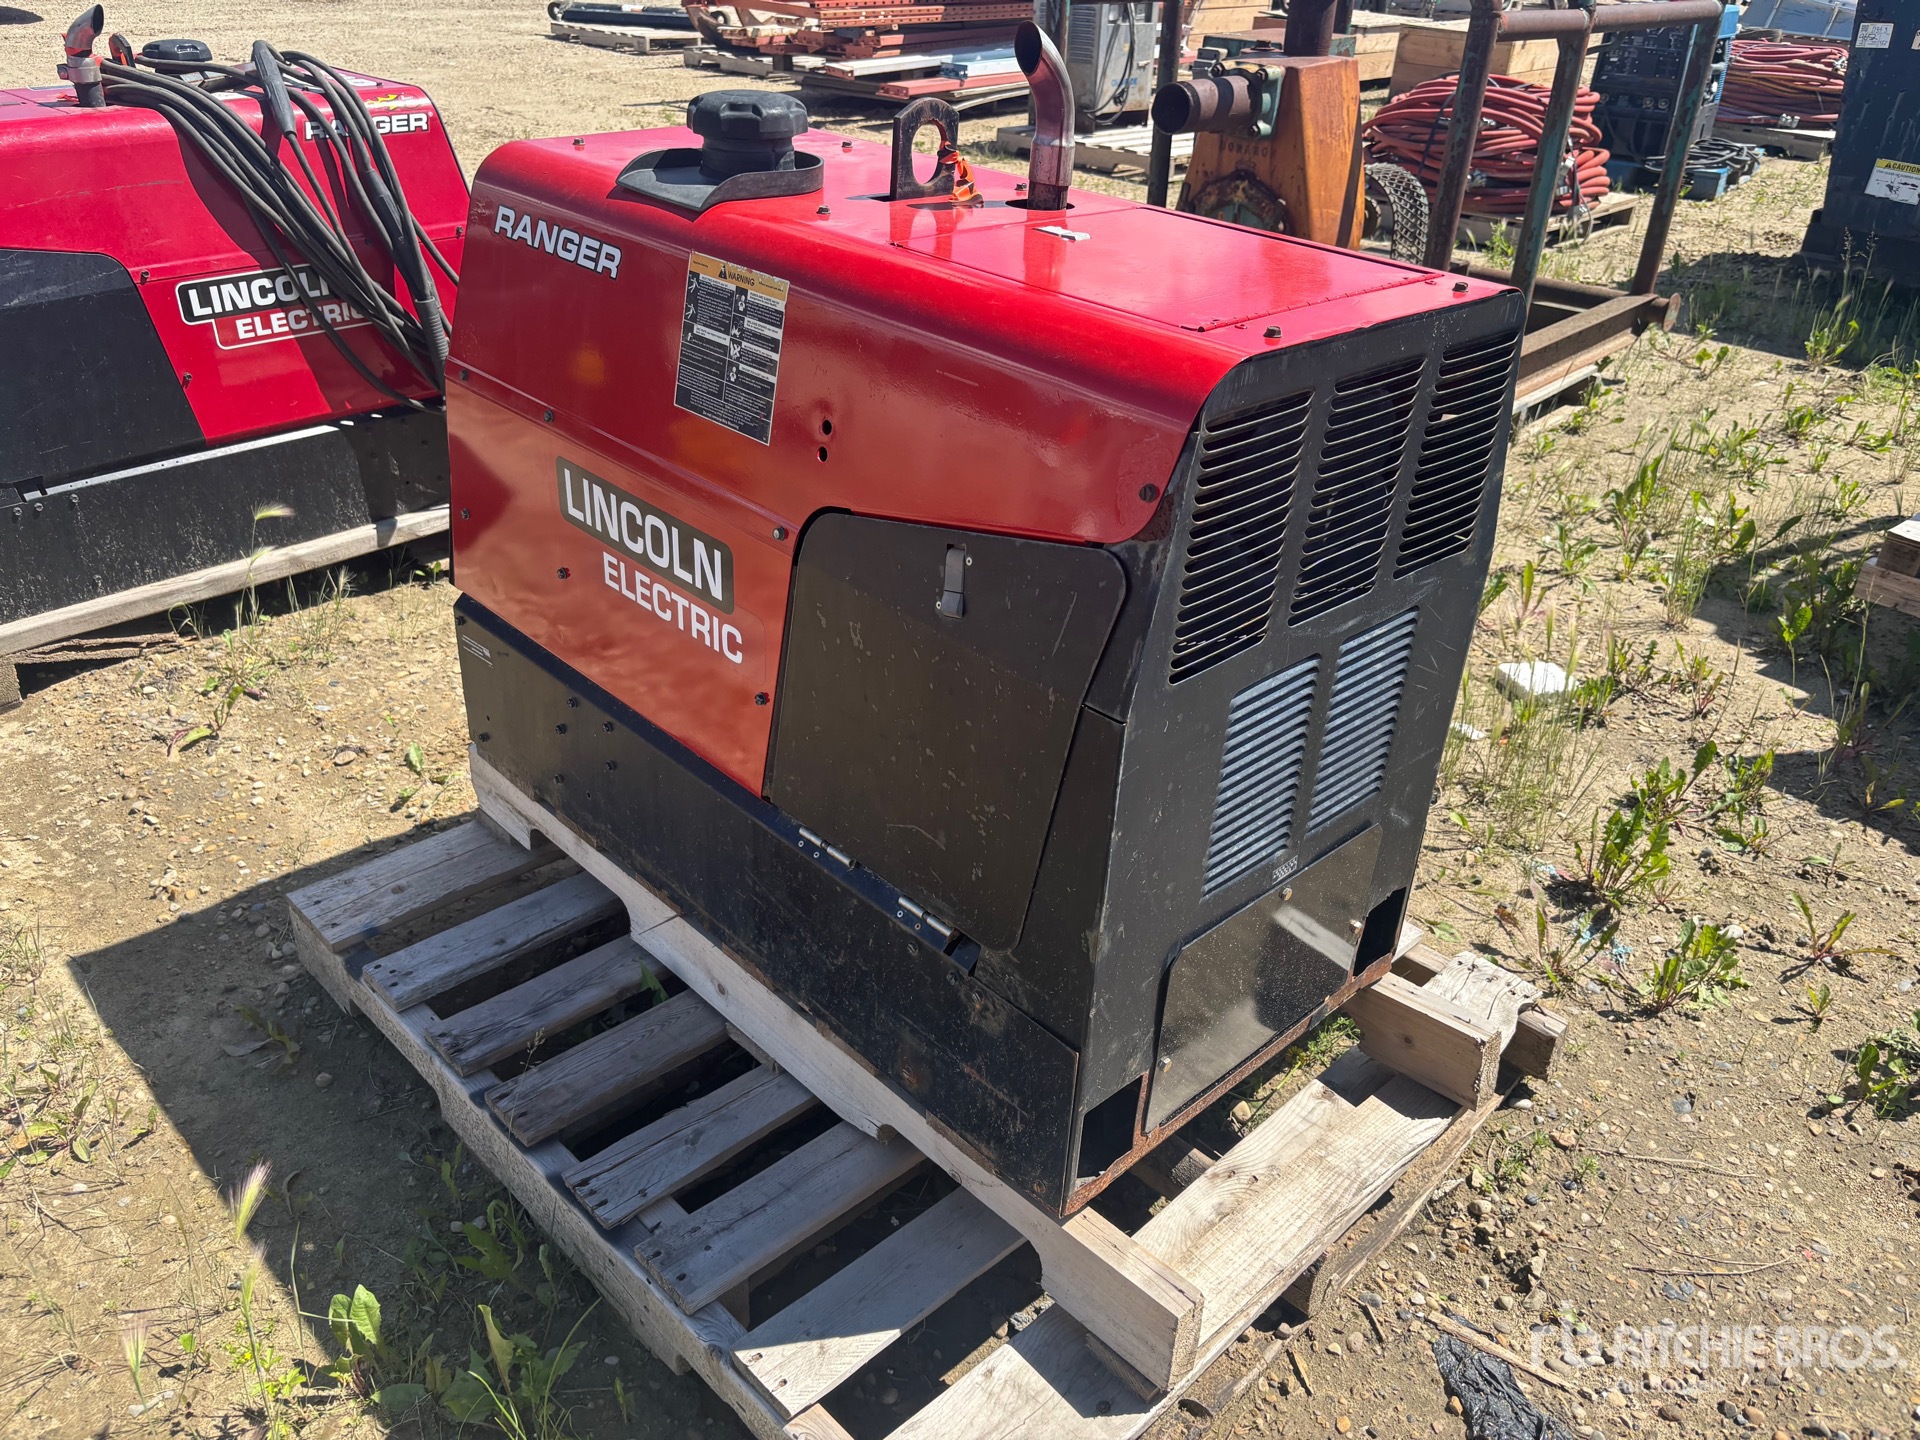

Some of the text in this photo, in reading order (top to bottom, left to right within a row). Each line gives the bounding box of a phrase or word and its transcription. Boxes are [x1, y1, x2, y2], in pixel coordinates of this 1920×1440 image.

[305, 113, 428, 140] RAGER
[494, 205, 622, 279] RANGER
[187, 272, 329, 316] LINCOL
[727, 271, 755, 287] WARNING
[564, 468, 723, 601] LINCOLN
[603, 551, 743, 664] ELECTRIC
